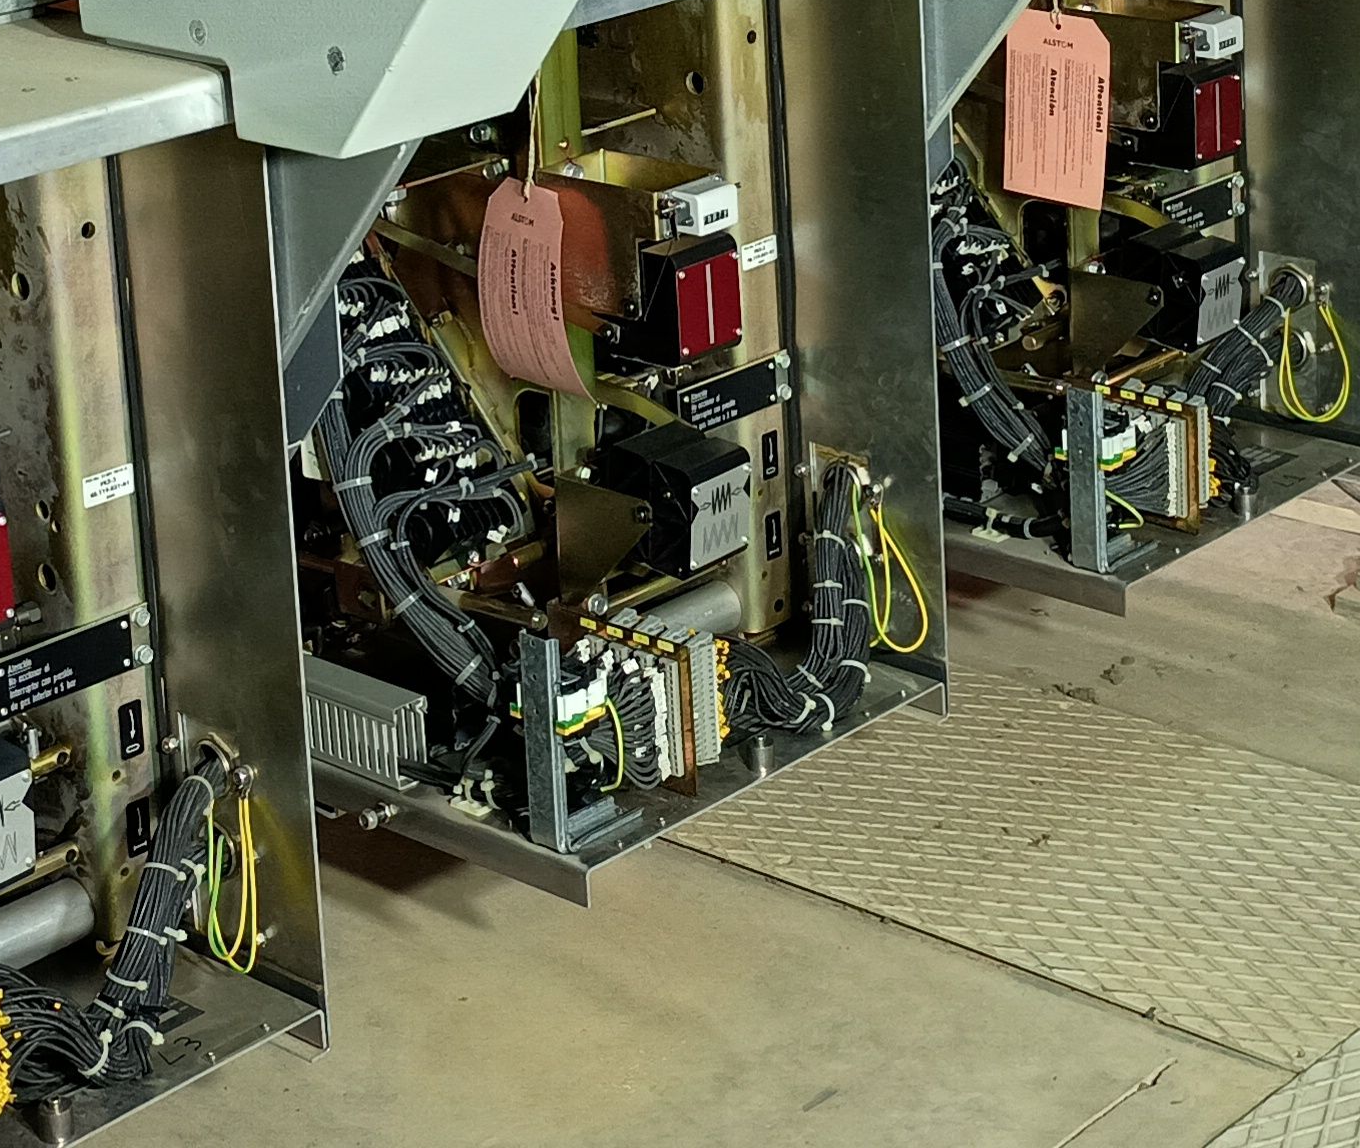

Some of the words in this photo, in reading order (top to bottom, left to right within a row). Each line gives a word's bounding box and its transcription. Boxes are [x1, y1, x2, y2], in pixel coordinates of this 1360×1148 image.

[1042, 38, 1074, 49] ALSTOM
[1049, 68, 1058, 116] Atención
[1095, 76, 1106, 133] Attention!
[510, 212, 535, 228] ALSTOM
[157, 1036, 202, 1066] L3
